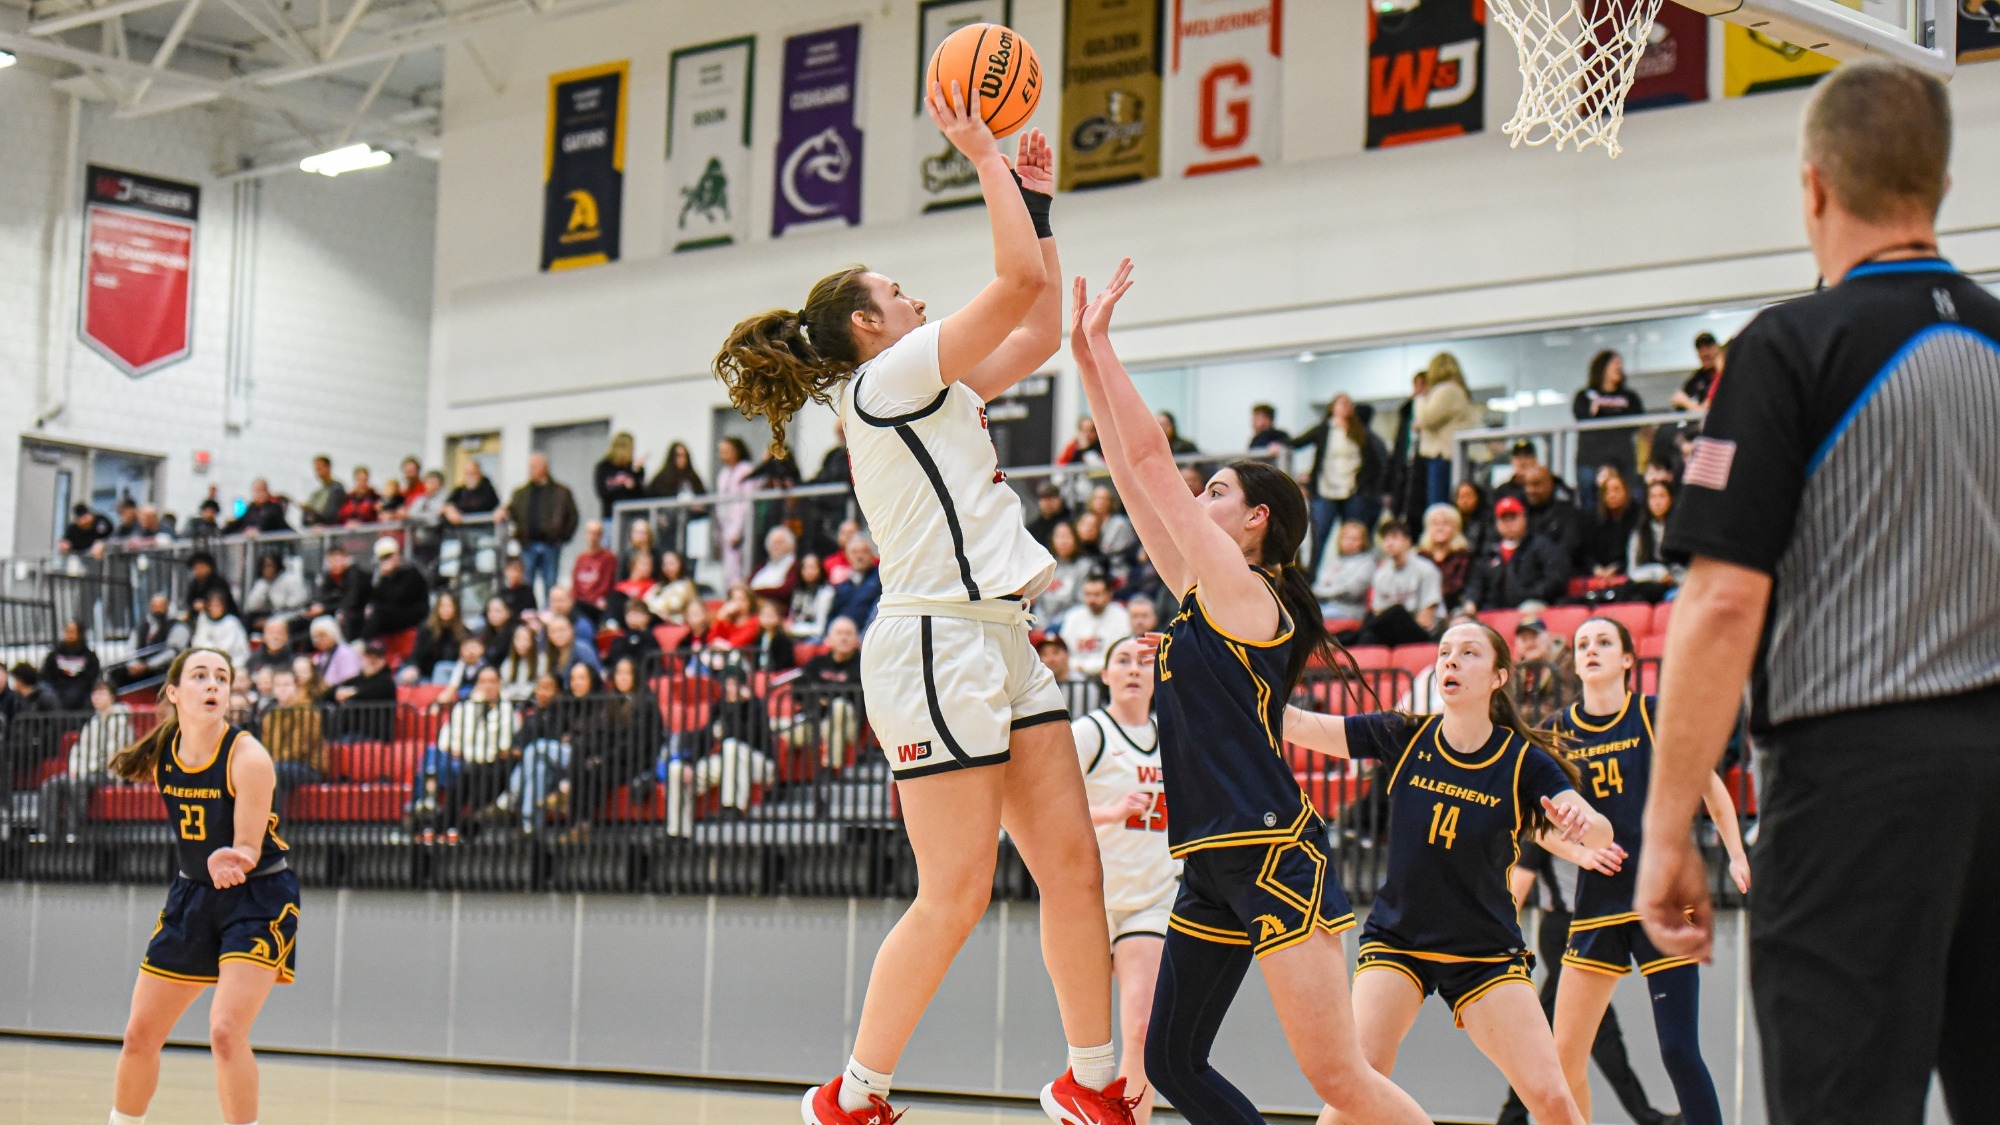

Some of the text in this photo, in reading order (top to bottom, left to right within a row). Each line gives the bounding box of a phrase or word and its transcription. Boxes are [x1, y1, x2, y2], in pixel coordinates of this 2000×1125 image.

[980, 31, 1014, 99] Wilson
[1370, 38, 1480, 117] W&J
[1199, 58, 1251, 152] G
[898, 741, 932, 763] W&J
[1409, 774, 1502, 808] ALLEGHENY
[1588, 757, 1623, 799] 24
[179, 803, 207, 841] 23
[1428, 801, 1461, 850] 14
